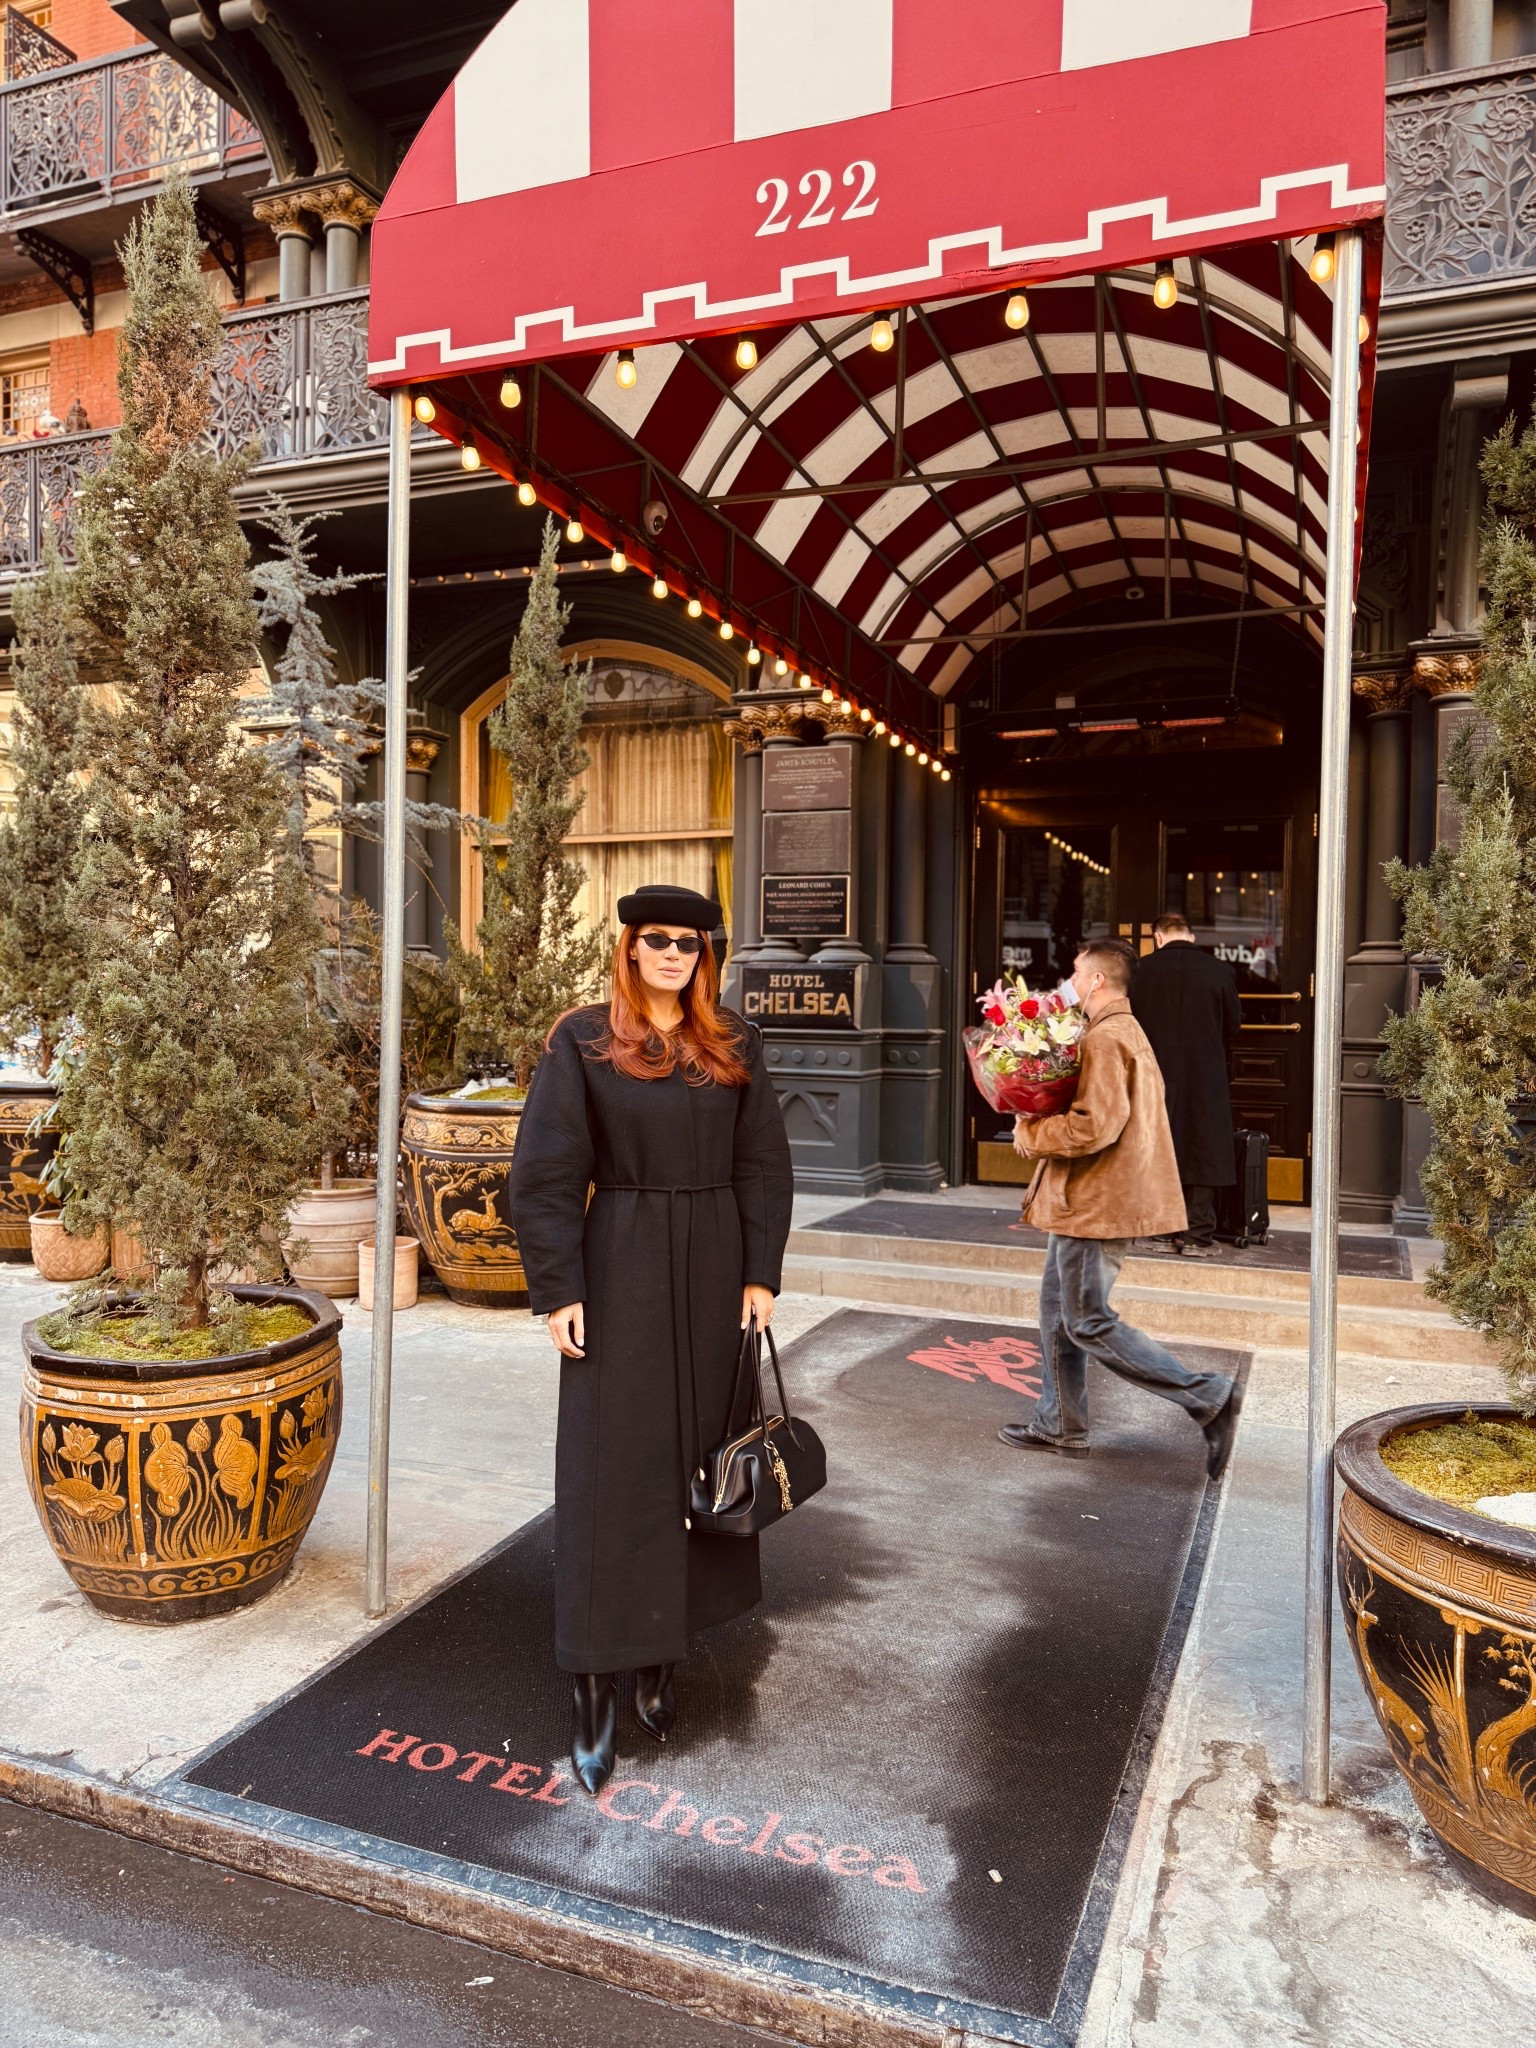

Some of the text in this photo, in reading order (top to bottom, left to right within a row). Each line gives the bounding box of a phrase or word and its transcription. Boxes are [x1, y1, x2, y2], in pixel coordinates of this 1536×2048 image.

[755, 160, 880, 238] 222
[744, 992, 852, 1016] CHELSEA
[769, 974, 825, 988] HOTEL
[355, 1728, 929, 1894] HOTEL Chelsea
